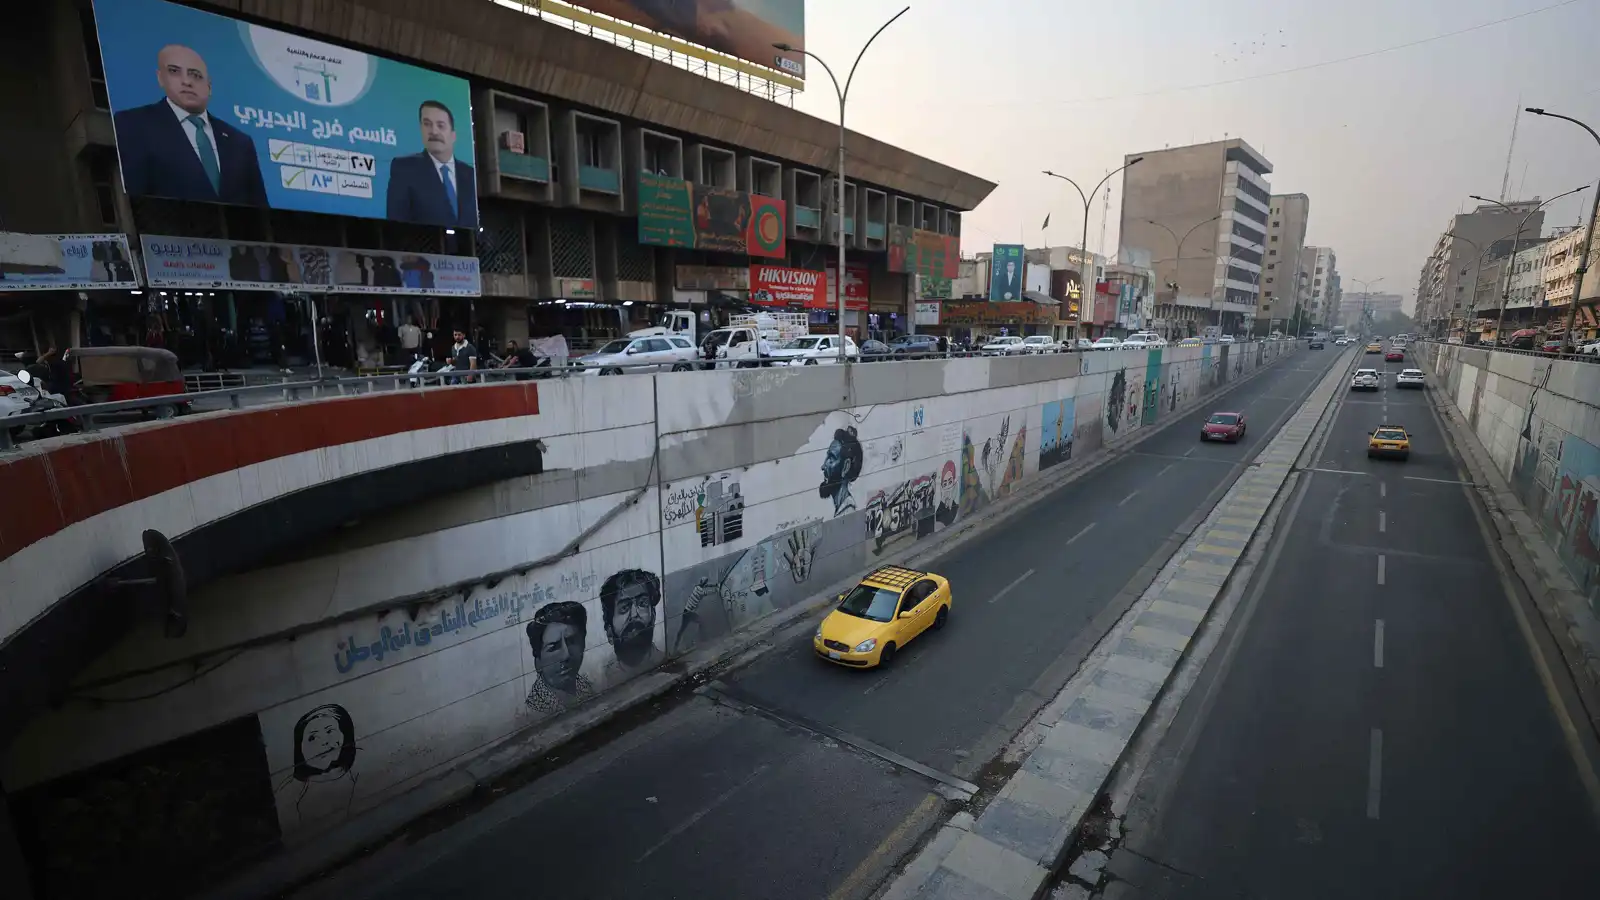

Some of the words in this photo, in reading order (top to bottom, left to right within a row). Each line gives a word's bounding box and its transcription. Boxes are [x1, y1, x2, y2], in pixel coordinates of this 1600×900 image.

[233, 104, 307, 132] البديري
[312, 118, 344, 140] فرج
[348, 126, 397, 146] قاسم
[350, 155, 374, 171] ٢٠٧
[311, 173, 333, 188] ٨٣
[759, 268, 818, 286] HIKVISION
[334, 625, 392, 674] الوطن
